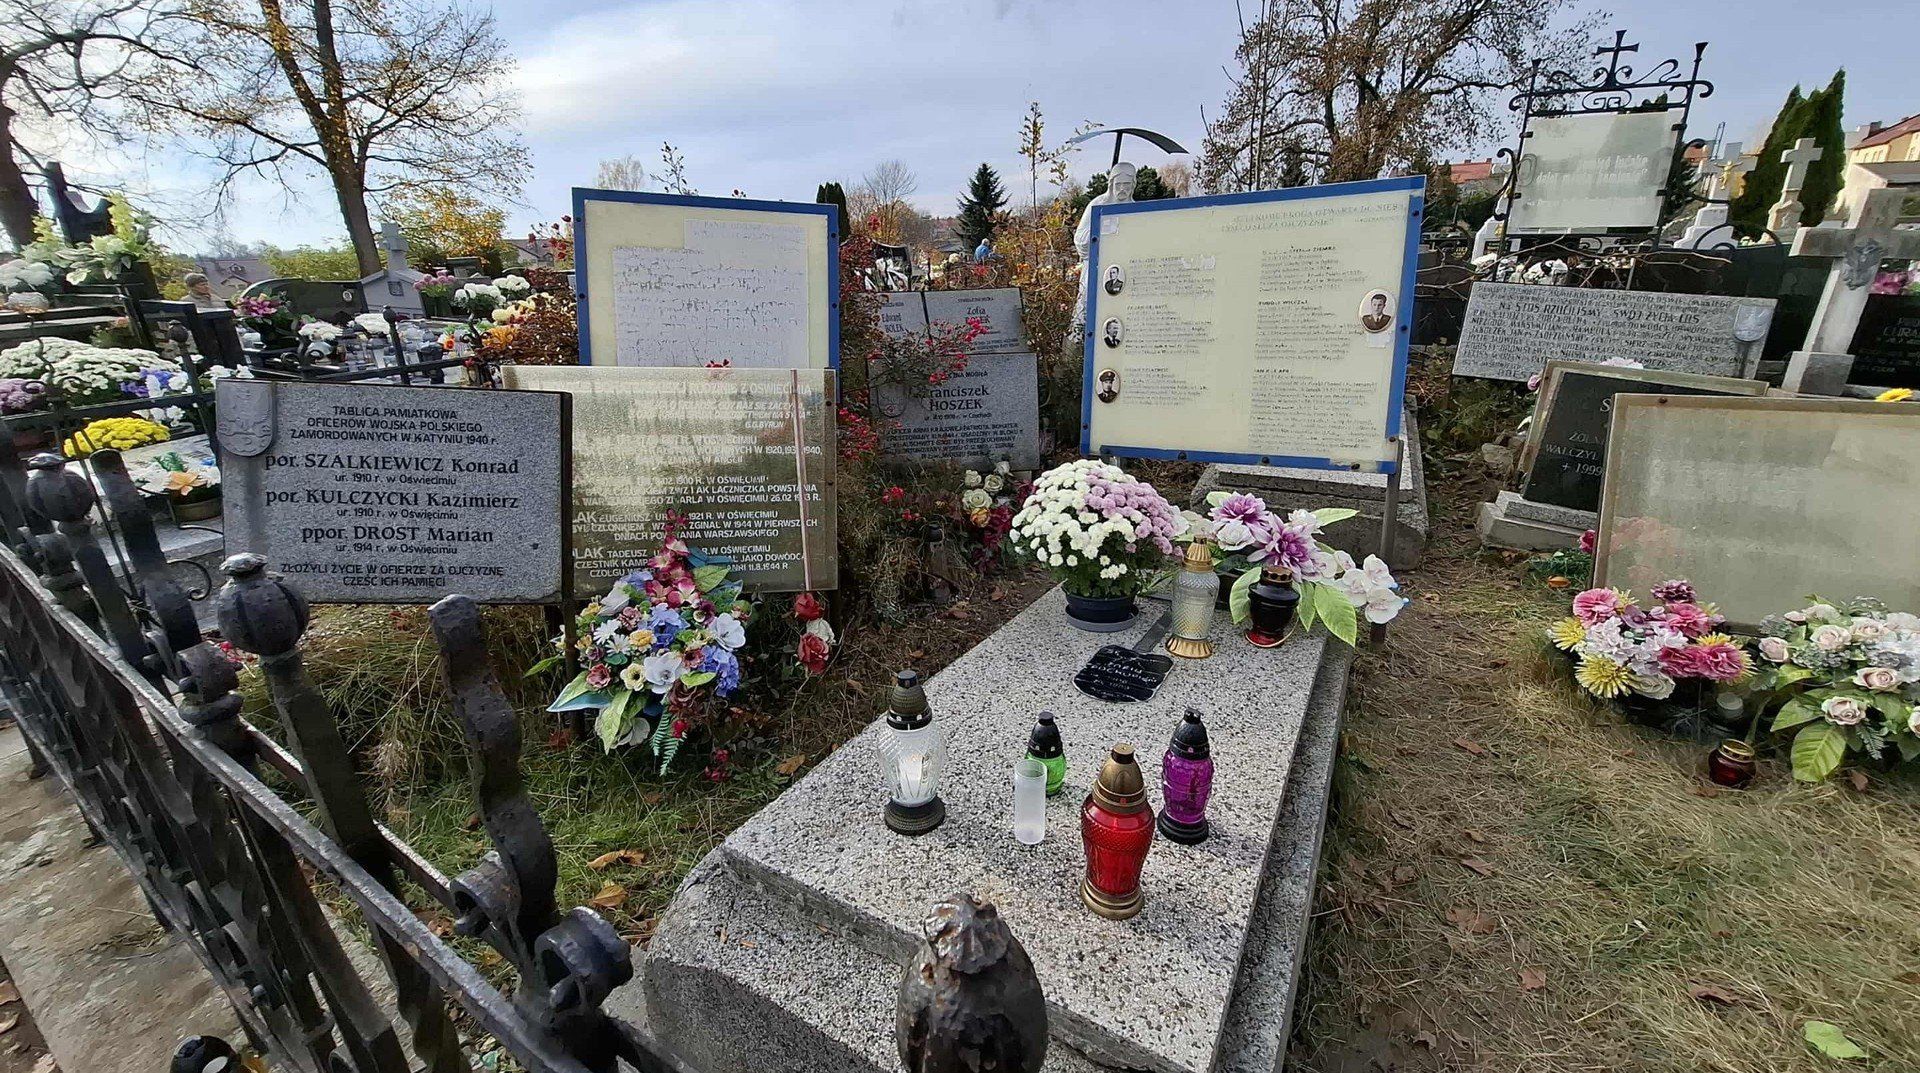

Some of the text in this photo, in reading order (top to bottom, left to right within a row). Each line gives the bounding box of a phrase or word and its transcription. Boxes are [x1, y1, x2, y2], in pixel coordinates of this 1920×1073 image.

[929, 384, 989, 398] ranciszek
[332, 405, 380, 416] TABLICA
[370, 418, 416, 430] WOJSKA
[420, 420, 482, 432] POLSKIEGO
[290, 428, 500, 446] ZAMORDOWANYCH W KATYNIU 1940 r.
[754, 446, 763, 455] W
[265, 453, 520, 474] por. SZALKIEWICZ Konrad
[352, 473, 372, 482] 1910
[706, 476, 715, 484] W
[696, 486, 710, 494] AK
[305, 489, 418, 506] KULCZYCKI
[426, 492, 520, 509] Kazimierz
[706, 496, 716, 504] W
[812, 493, 822, 502] R.
[336, 509, 350, 517] ur.
[354, 508, 374, 517] 1910
[722, 521, 732, 529] W
[734, 520, 752, 529] 1944
[754, 520, 763, 528] W
[764, 518, 818, 528] PIERWSZCH
[302, 525, 494, 544] ppor. DROST Marian
[614, 532, 648, 541] DNIACH
[704, 529, 779, 538] WARSZAWSKIEGO
[352, 542, 372, 552] 1914
[606, 549, 648, 558] TADEUSZ
[741, 554, 763, 562] JAKO
[280, 562, 328, 574] ZŁOŻYLI
[366, 564, 377, 574] W
[380, 565, 427, 575] OFIERZE
[430, 566, 445, 575] ZA
[381, 578, 398, 587] ICH
